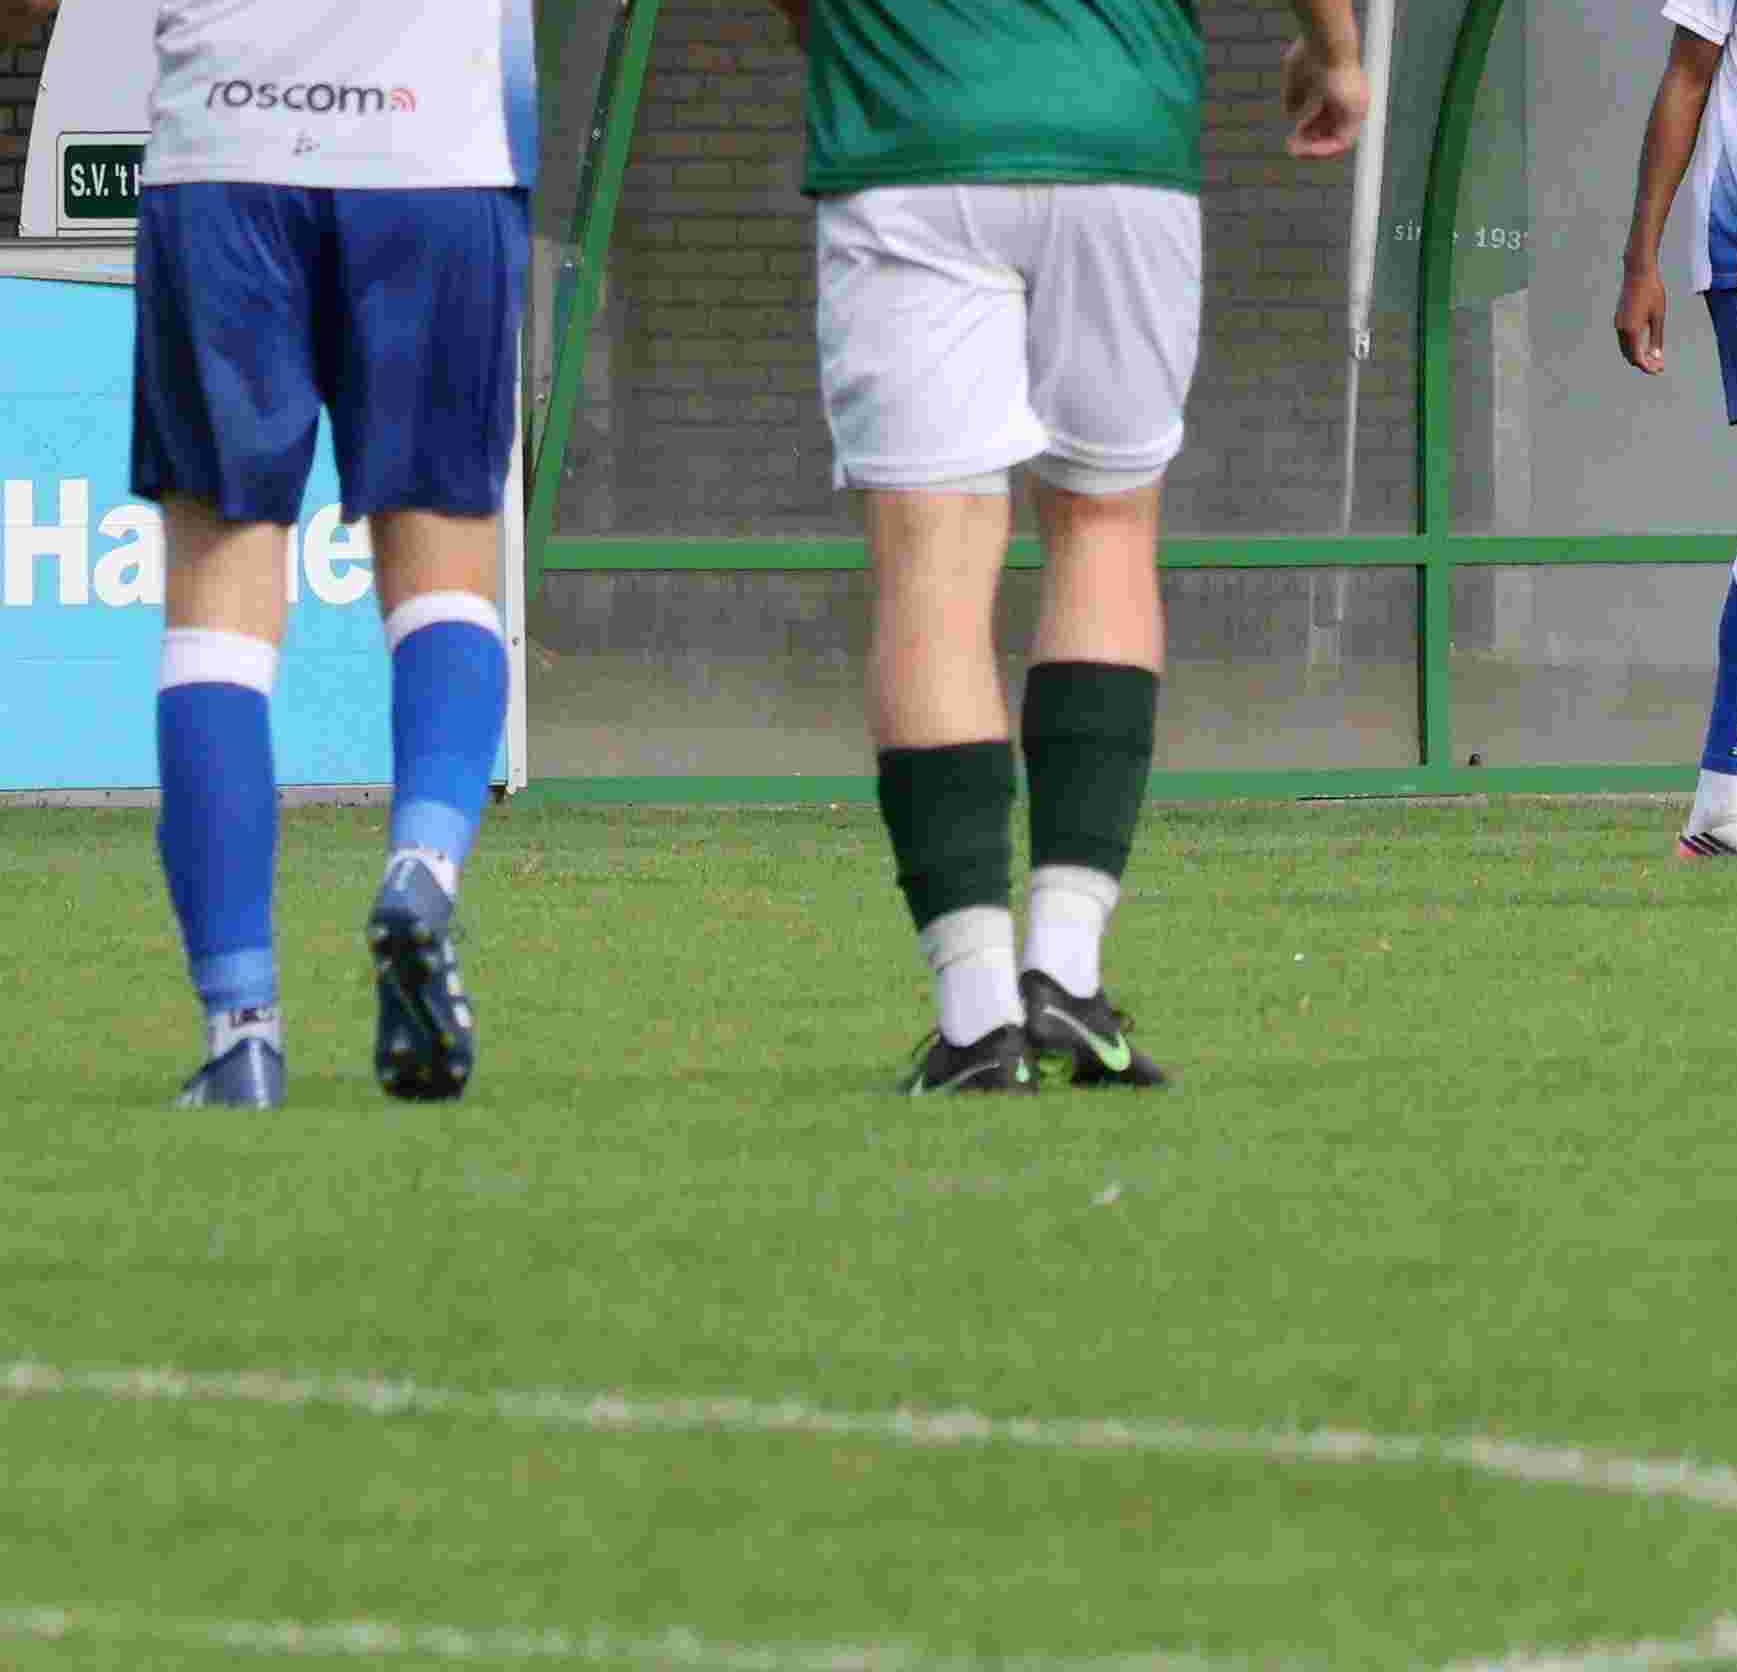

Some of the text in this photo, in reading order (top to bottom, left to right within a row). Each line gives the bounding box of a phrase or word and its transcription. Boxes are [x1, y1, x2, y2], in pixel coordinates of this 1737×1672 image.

[205, 79, 385, 116] roscom
[70, 162, 109, 196] S.V.
[3, 478, 374, 607] Hae
